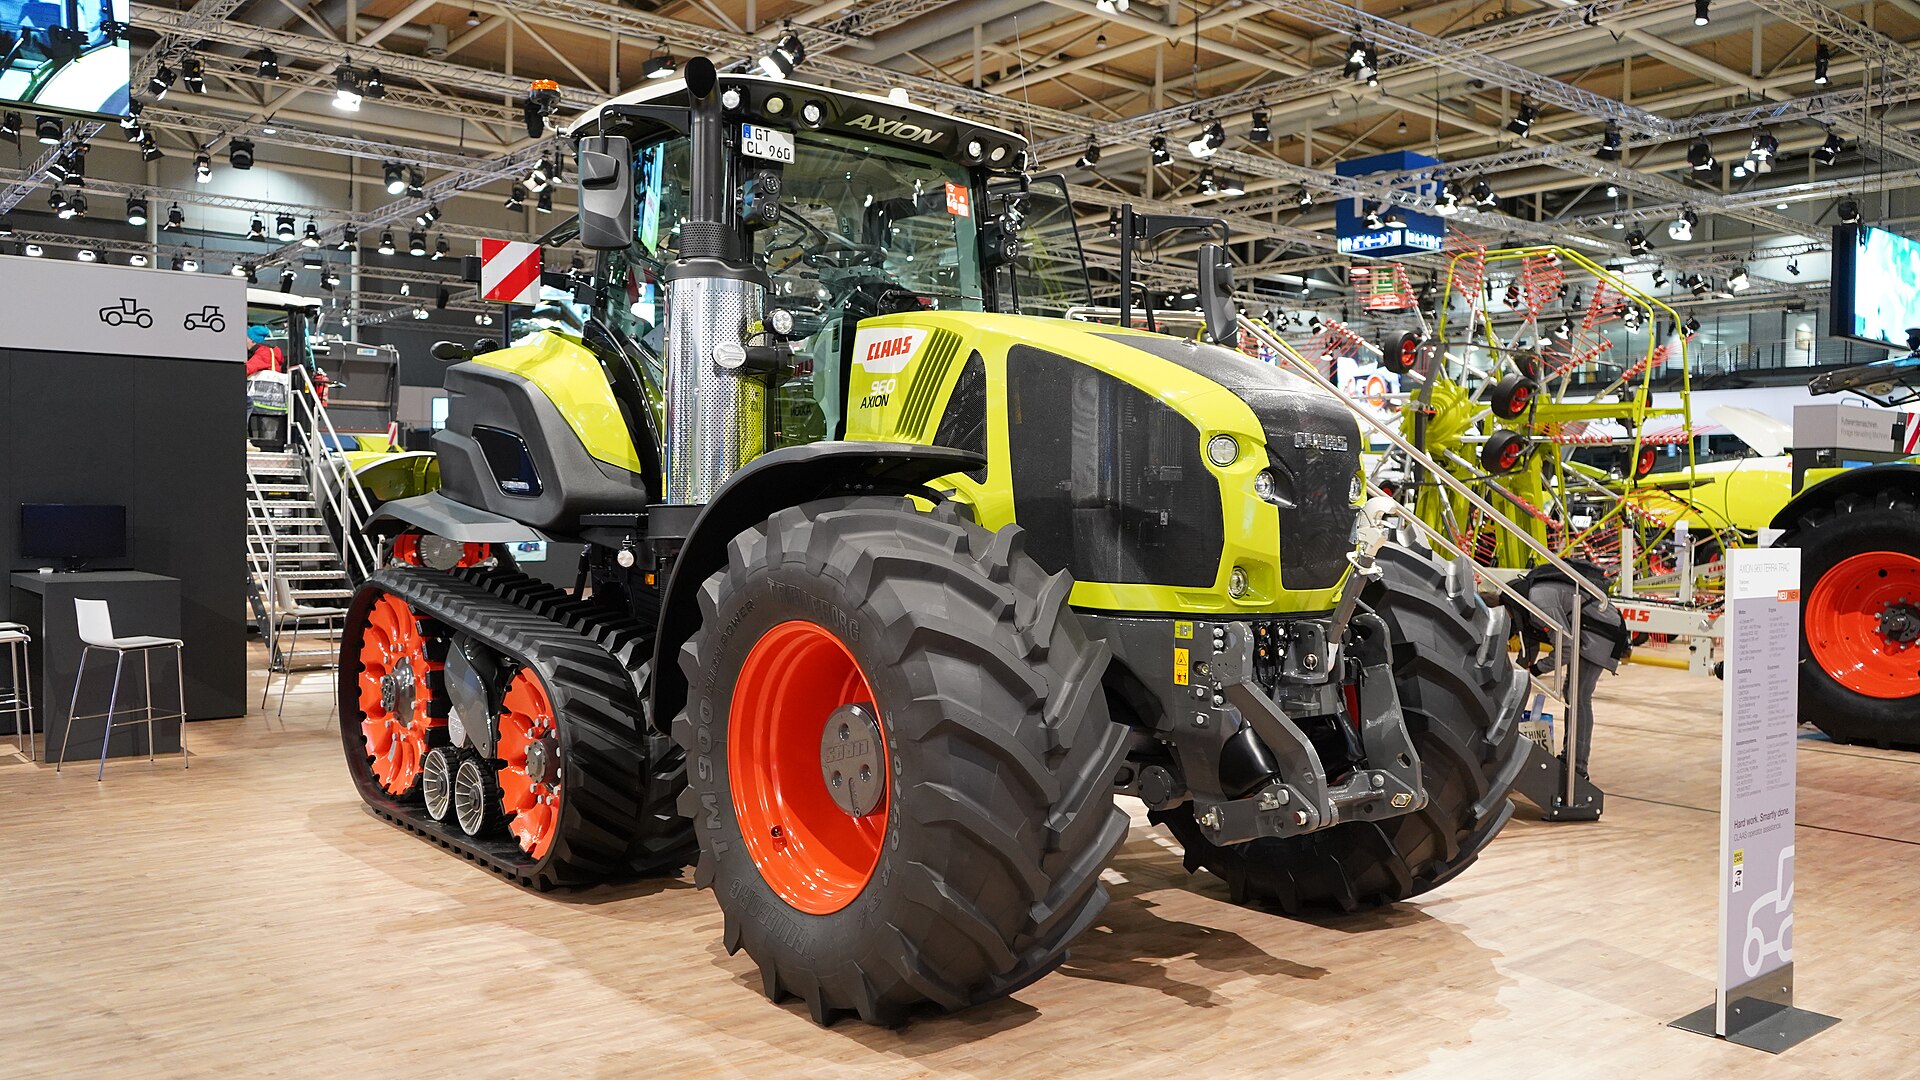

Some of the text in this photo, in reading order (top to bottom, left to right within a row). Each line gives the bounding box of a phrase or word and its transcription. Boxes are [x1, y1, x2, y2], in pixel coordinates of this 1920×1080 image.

[755, 128, 770, 142] GT
[845, 114, 944, 144] AXION
[747, 140, 791, 160] CL 960
[866, 335, 913, 361] CLAAS
[870, 379, 896, 395] 960
[860, 394, 890, 409] AXION
[720, 599, 756, 648] POWER
[1734, 818, 1746, 830] Hard
[1760, 810, 1777, 822] Smartly
[729, 878, 817, 964] TRELLEBORG
